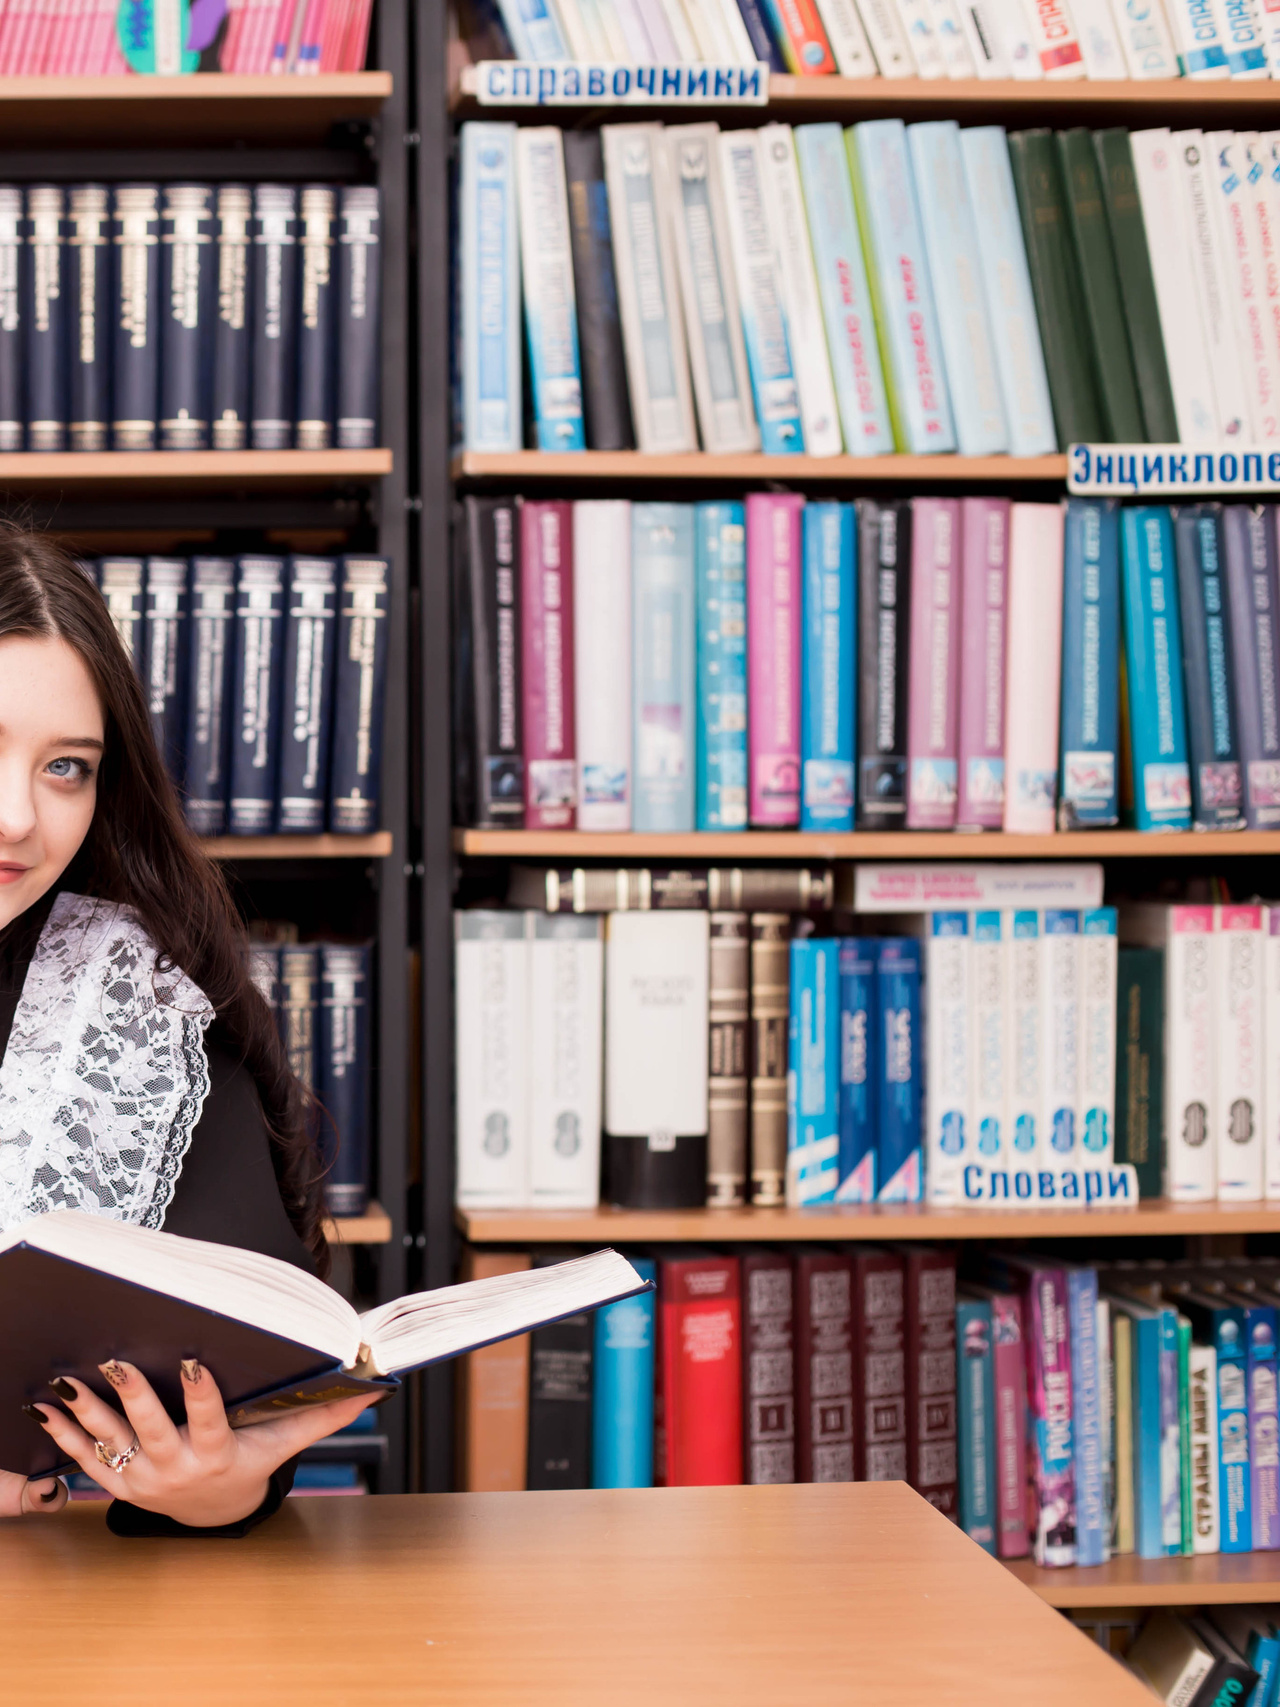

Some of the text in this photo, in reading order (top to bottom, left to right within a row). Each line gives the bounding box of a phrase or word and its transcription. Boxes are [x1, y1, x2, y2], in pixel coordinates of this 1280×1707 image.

[487, 65, 761, 105] справочники
[963, 1165, 1130, 1206] Словари
[1192, 1367, 1212, 1538] СТРАНЫ МИРА
